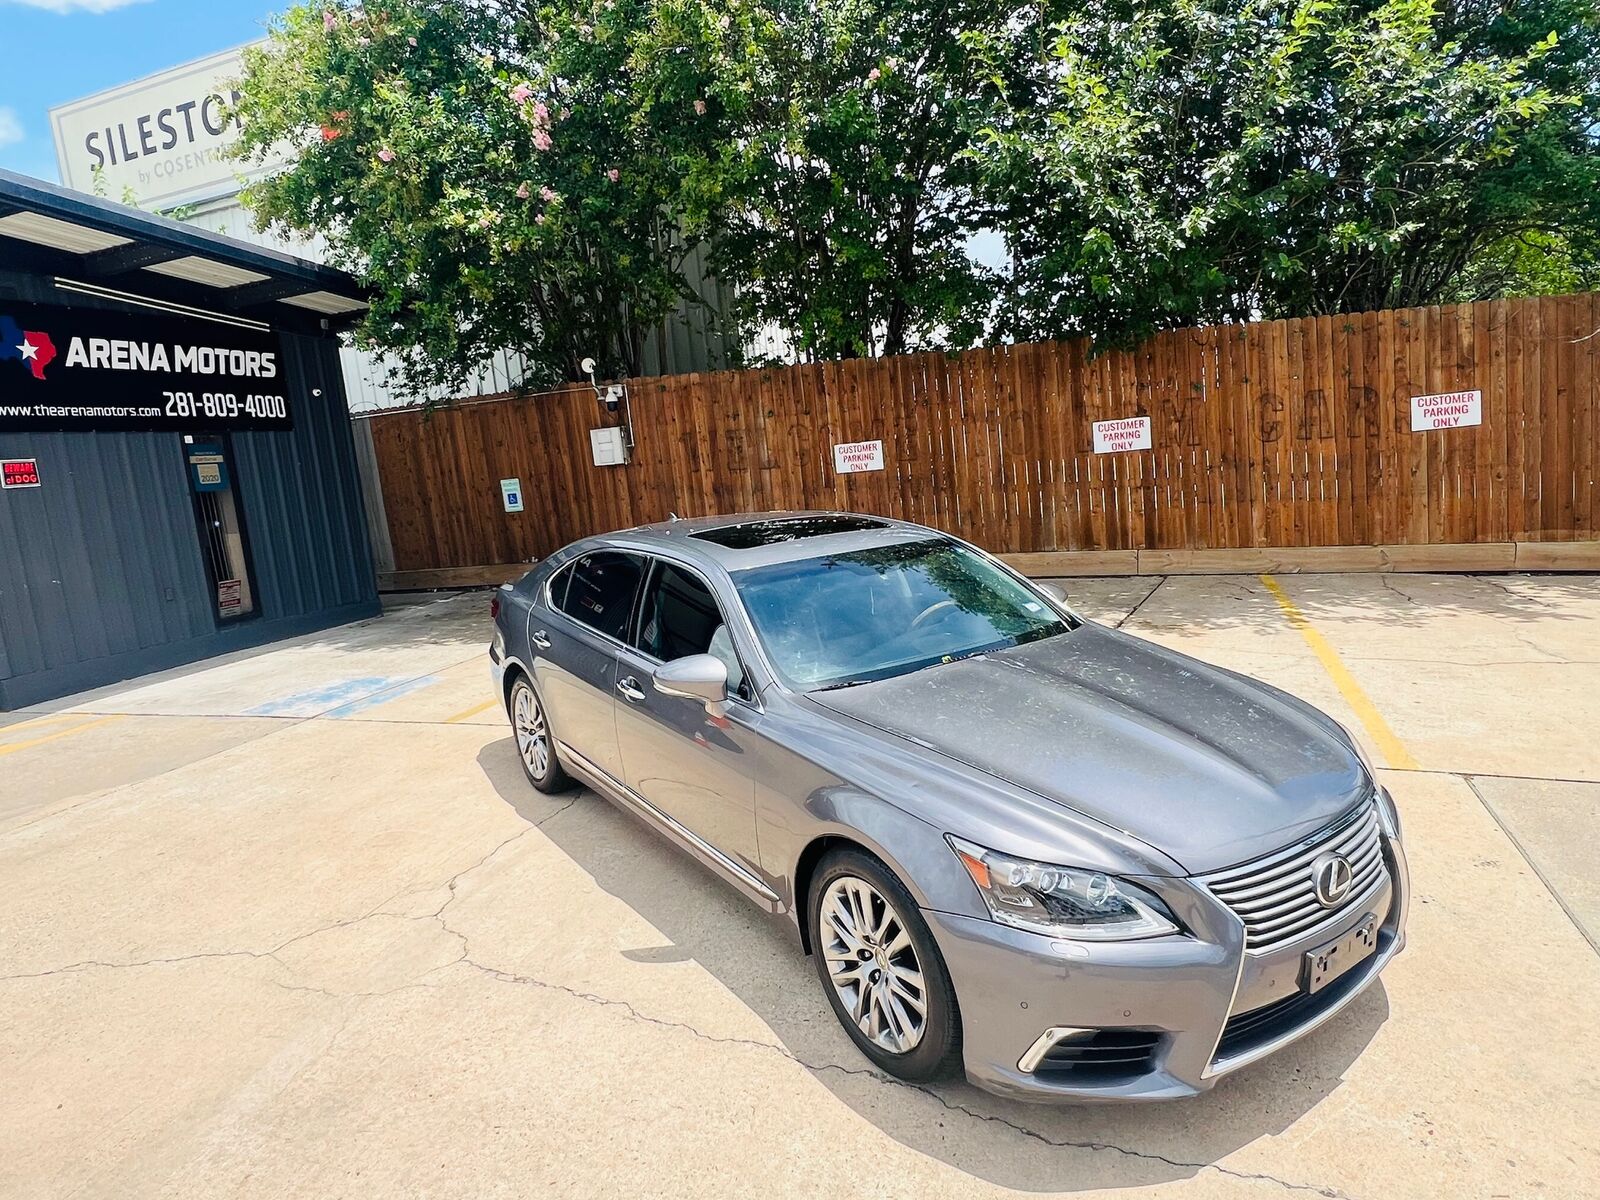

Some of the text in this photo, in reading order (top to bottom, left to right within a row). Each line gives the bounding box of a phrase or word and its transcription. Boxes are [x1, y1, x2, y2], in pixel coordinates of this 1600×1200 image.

[138, 169, 151, 185] by
[65, 336, 276, 378] ARENA MOTORS
[162, 391, 287, 418] 281-809-4000
[1417, 392, 1474, 408] CUSTOMER
[1423, 405, 1469, 418] PARKING
[1098, 420, 1145, 432] CUSTOMER
[1433, 417, 1459, 428] ONLY
[1103, 430, 1141, 441] PARKING
[838, 443, 878, 454] CUSTOMER
[1111, 441, 1133, 451] ONLY
[843, 453, 875, 463] PARKING
[4, 463, 34, 472] BEWARE
[850, 463, 868, 471] ONLY
[15, 474, 37, 483] DOG
[201, 475, 220, 483] 2020
